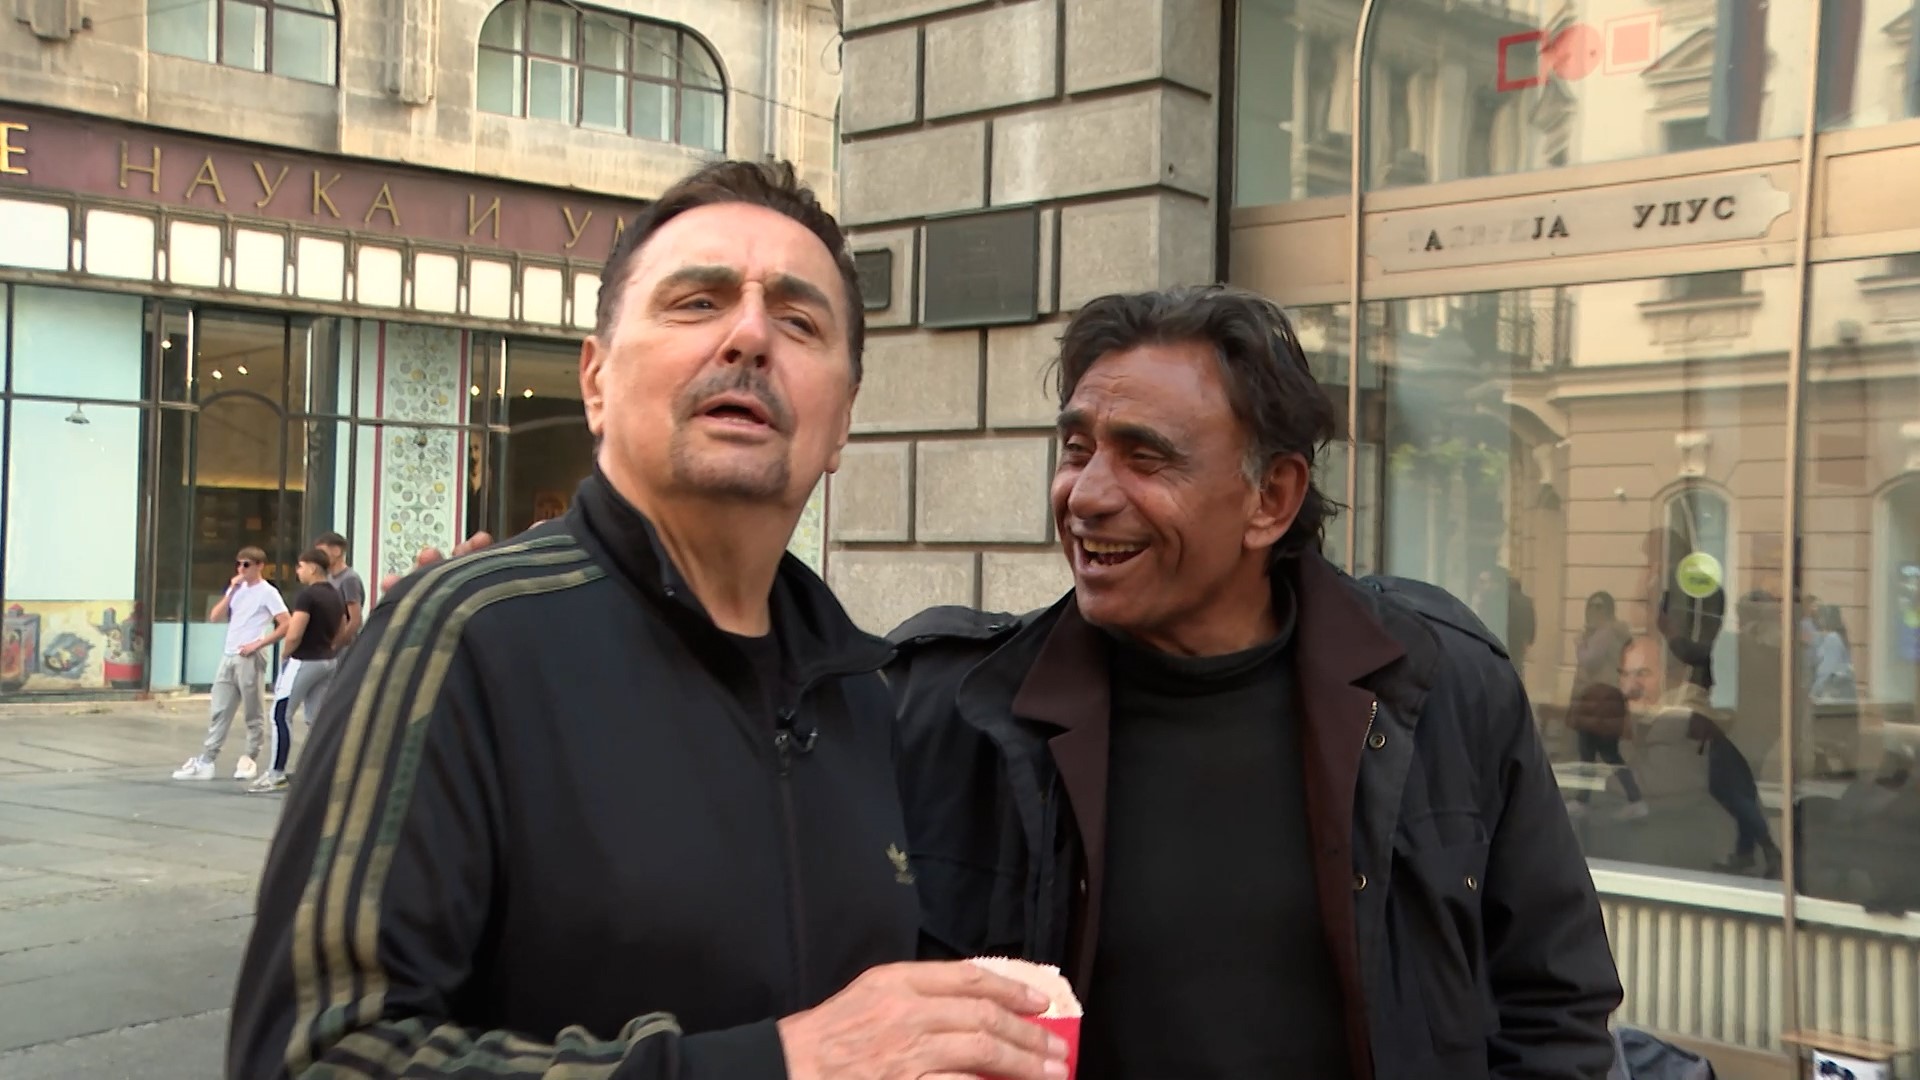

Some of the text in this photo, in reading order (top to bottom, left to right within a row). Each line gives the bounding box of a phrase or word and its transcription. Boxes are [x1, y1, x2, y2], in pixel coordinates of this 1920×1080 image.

[118, 139, 400, 226] НАУКА
[468, 193, 501, 240] И
[1633, 195, 1736, 229] УЛУС
